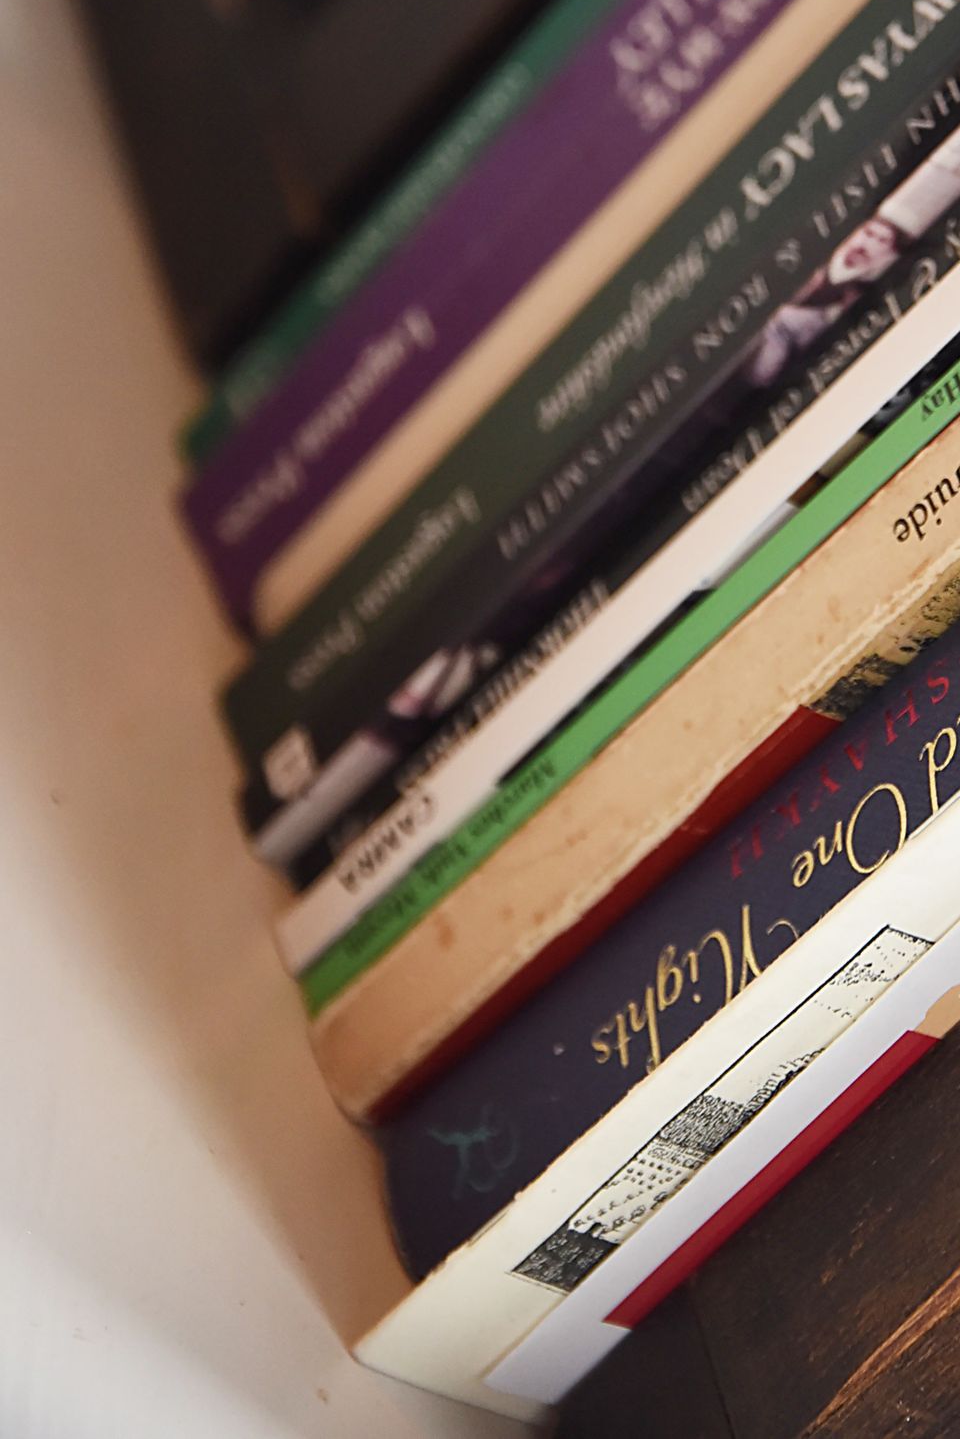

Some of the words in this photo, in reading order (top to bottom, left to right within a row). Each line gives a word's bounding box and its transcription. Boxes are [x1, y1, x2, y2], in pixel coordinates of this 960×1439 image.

[736, 93, 845, 210] LACY
[690, 272, 772, 360] RON
[900, 255, 944, 298] &
[787, 779, 928, 919] One
[583, 893, 804, 1097] Nights
